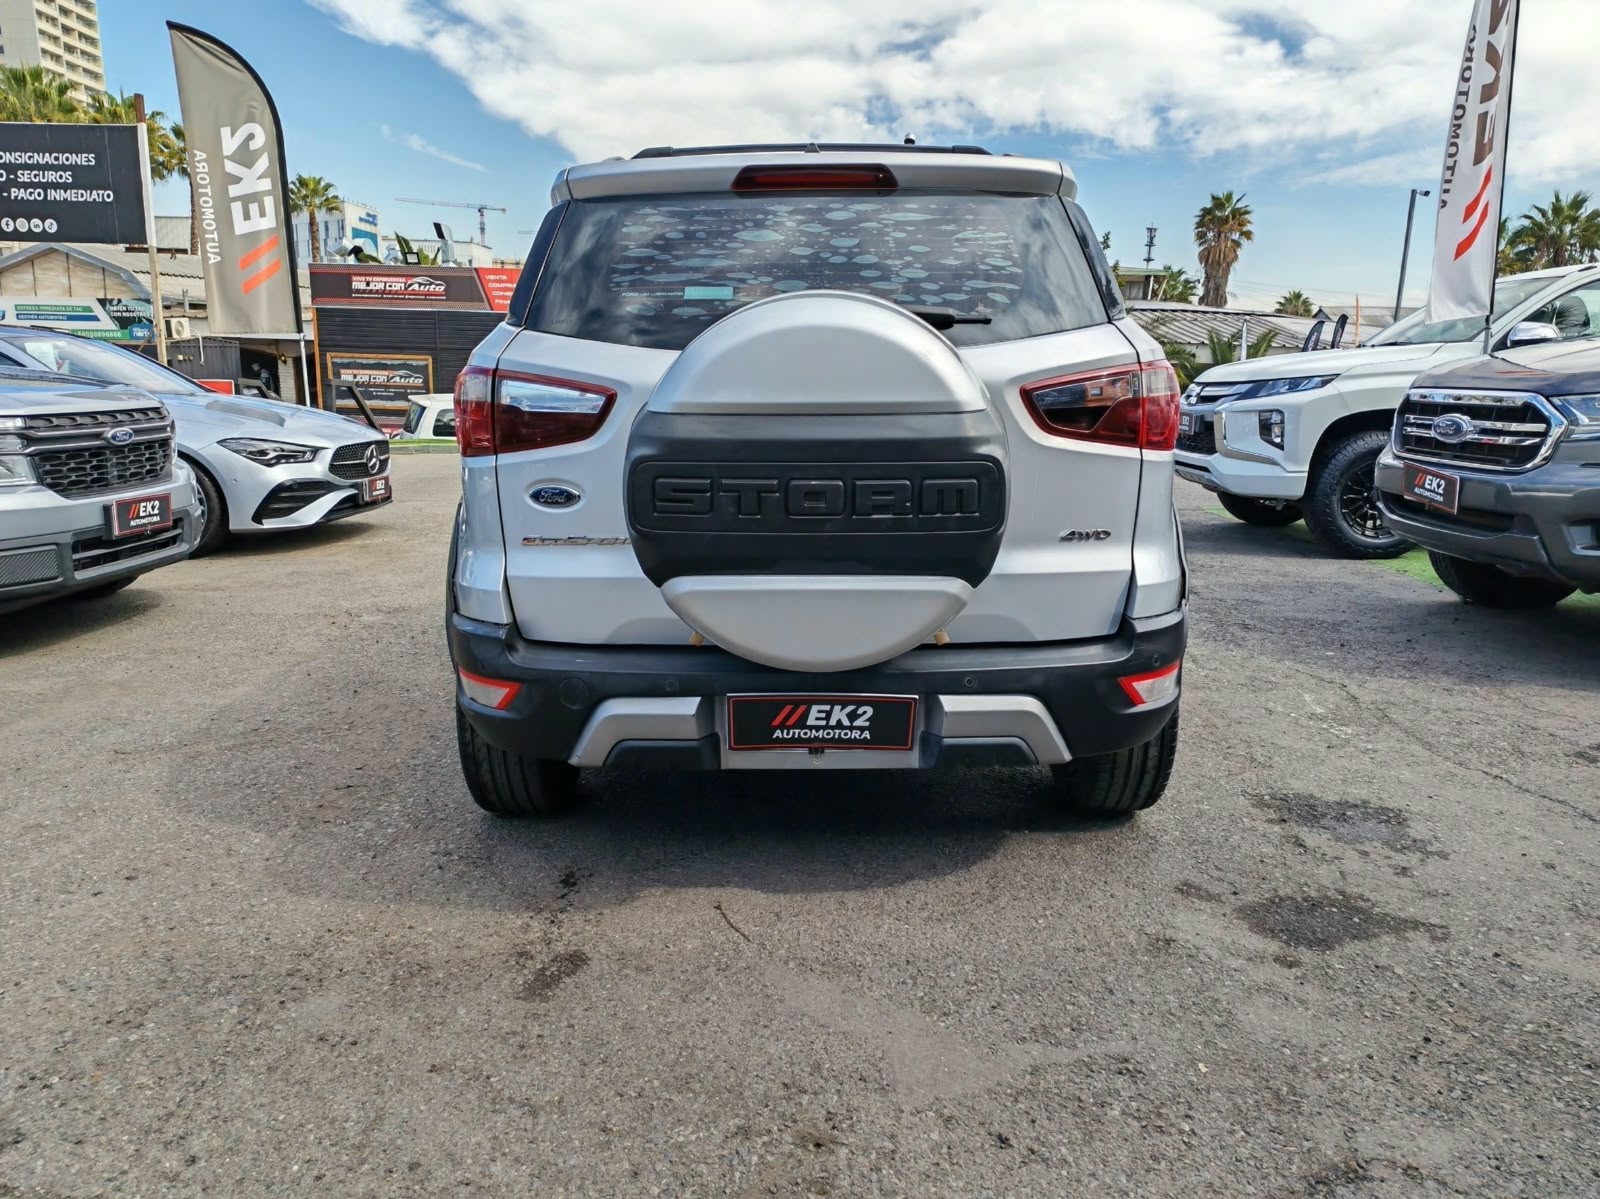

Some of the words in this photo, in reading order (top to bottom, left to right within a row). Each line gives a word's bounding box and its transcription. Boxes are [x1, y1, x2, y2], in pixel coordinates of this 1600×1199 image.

[17, 170, 73, 184] SEGUROS
[11, 188, 44, 201] PAGO
[47, 188, 114, 203] INMEDIATO
[352, 281, 385, 290] MEJOR
[386, 282, 405, 291] CON
[407, 283, 446, 292] Auto
[389, 376, 423, 384] Auto
[1424, 475, 1446, 494] EK2
[539, 487, 568, 503] Ford
[653, 477, 981, 519] STORM
[1414, 487, 1444, 502] AUTOMOTORA
[140, 500, 160, 517] EK2
[130, 515, 161, 527] AUTOMOTORA
[806, 704, 874, 727] EK2
[772, 729, 871, 740] AUTOMOTORA
